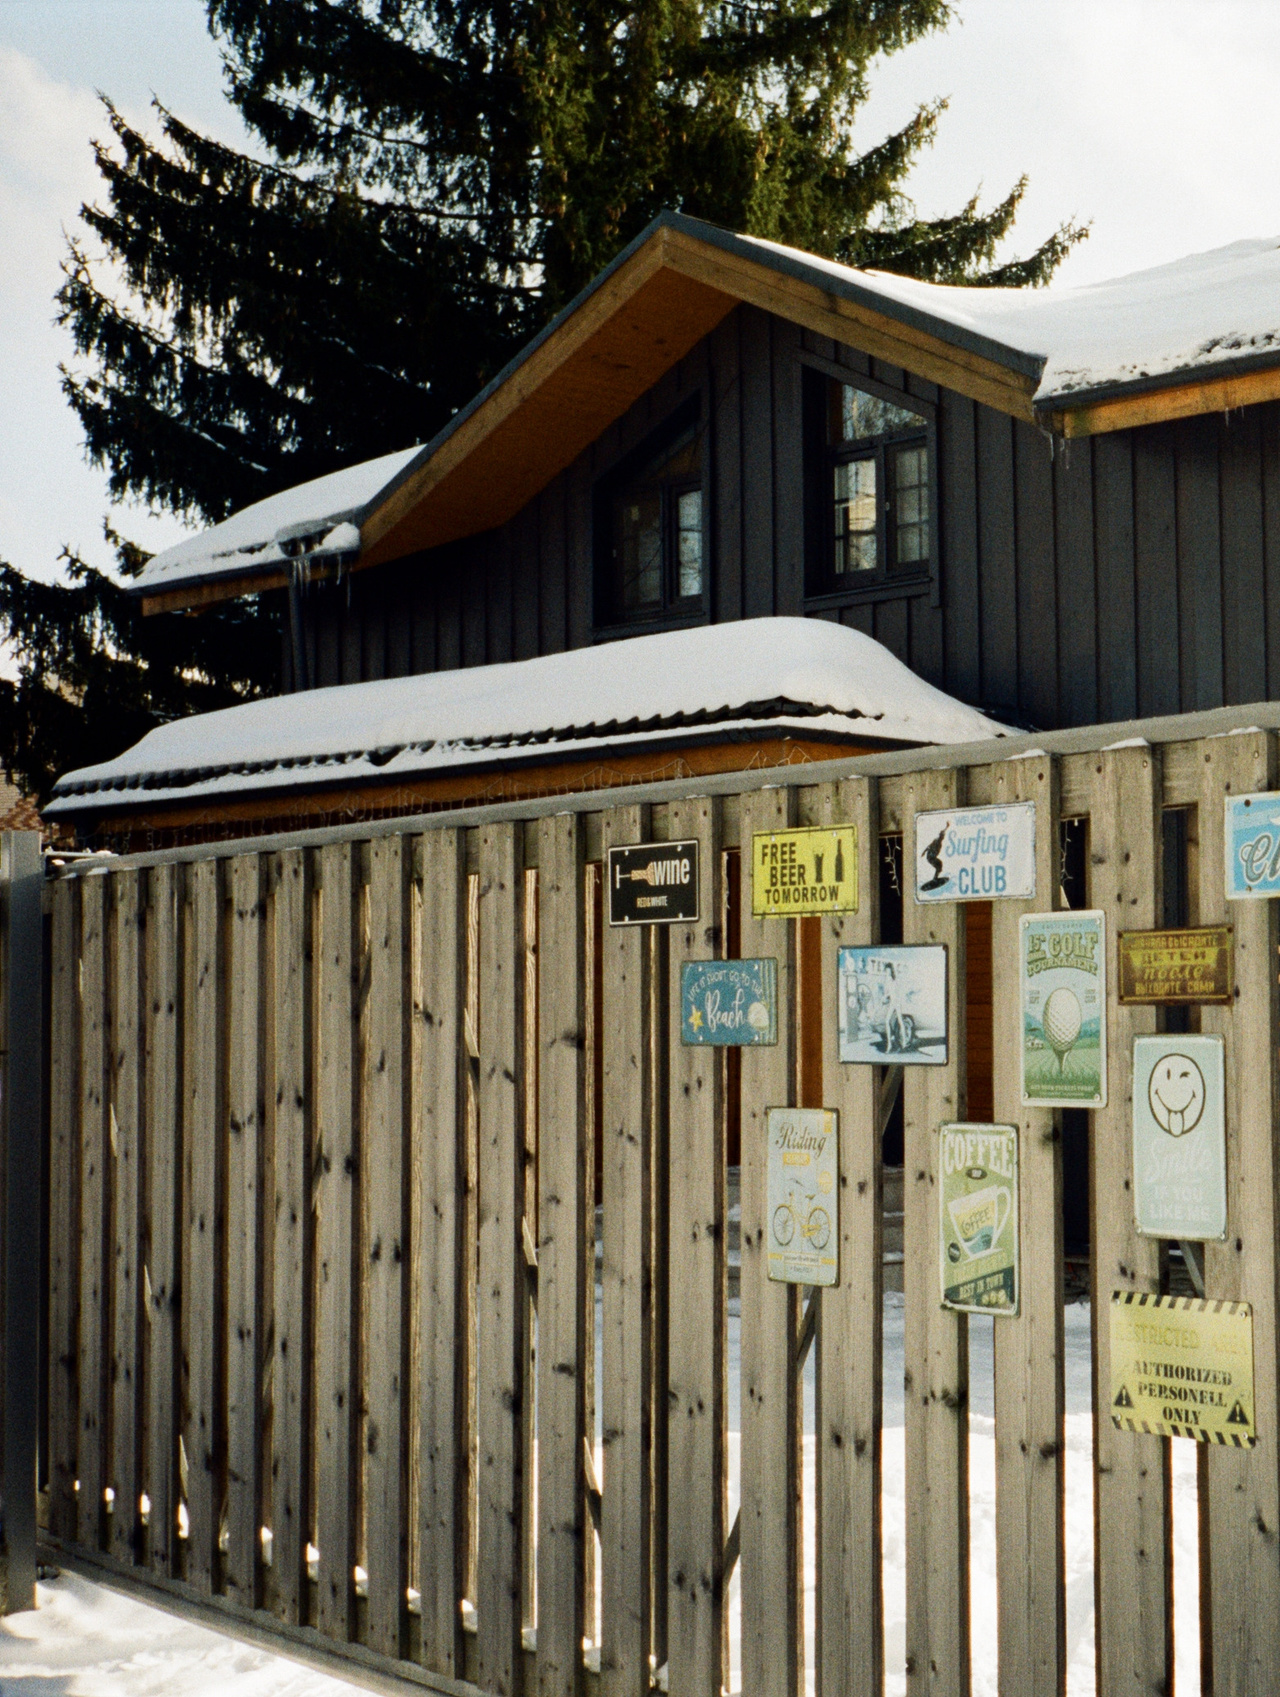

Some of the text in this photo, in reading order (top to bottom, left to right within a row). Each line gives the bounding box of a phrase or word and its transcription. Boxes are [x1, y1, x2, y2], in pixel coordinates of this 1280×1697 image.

[954, 811, 1008, 826] WELCOME TO
[761, 841, 797, 866] FREE
[945, 827, 1009, 863] Surfing
[653, 858, 690, 886] wine
[770, 864, 806, 887] BEER
[958, 865, 1007, 895] CLUB
[764, 885, 839, 905] TOMORROW
[1048, 932, 1098, 960] GOLF
[1026, 957, 1098, 978] TOURNAMENT
[704, 988, 746, 1033] Beach
[775, 1122, 827, 1161] Riding
[944, 1132, 1013, 1179] COFFEE
[1133, 1360, 1233, 1386] AUTHORIZED
[1138, 1381, 1228, 1407] PERSONELL
[1162, 1406, 1202, 1425] ONLY
